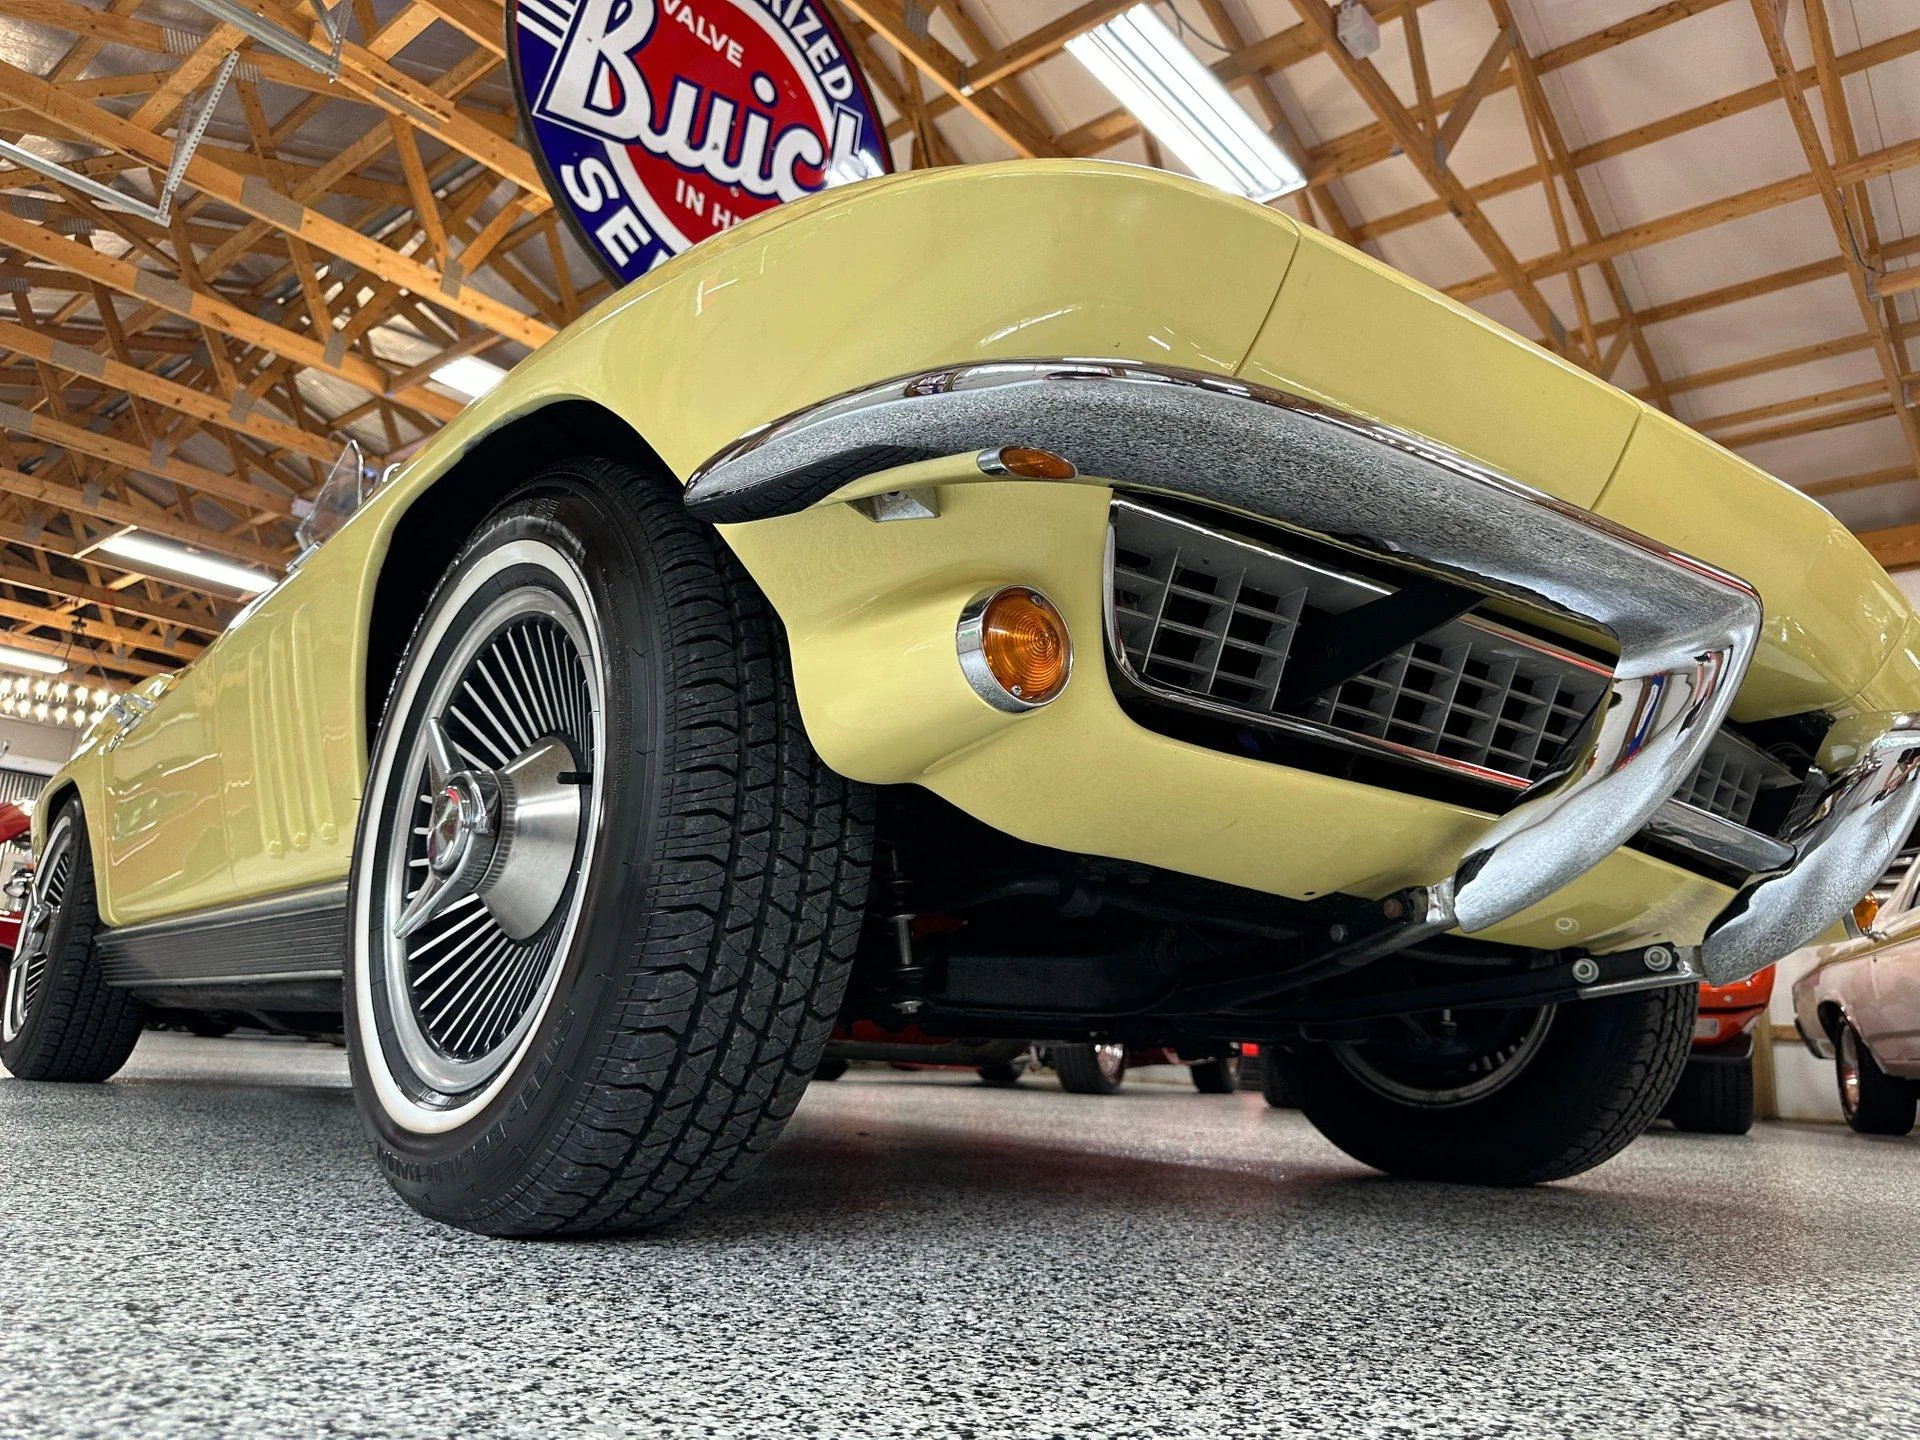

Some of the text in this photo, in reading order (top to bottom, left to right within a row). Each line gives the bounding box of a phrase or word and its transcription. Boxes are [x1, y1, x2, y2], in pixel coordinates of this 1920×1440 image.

[662, 0, 745, 69] VALVE
[560, 157, 677, 272] SE
[674, 179, 706, 217] IN
